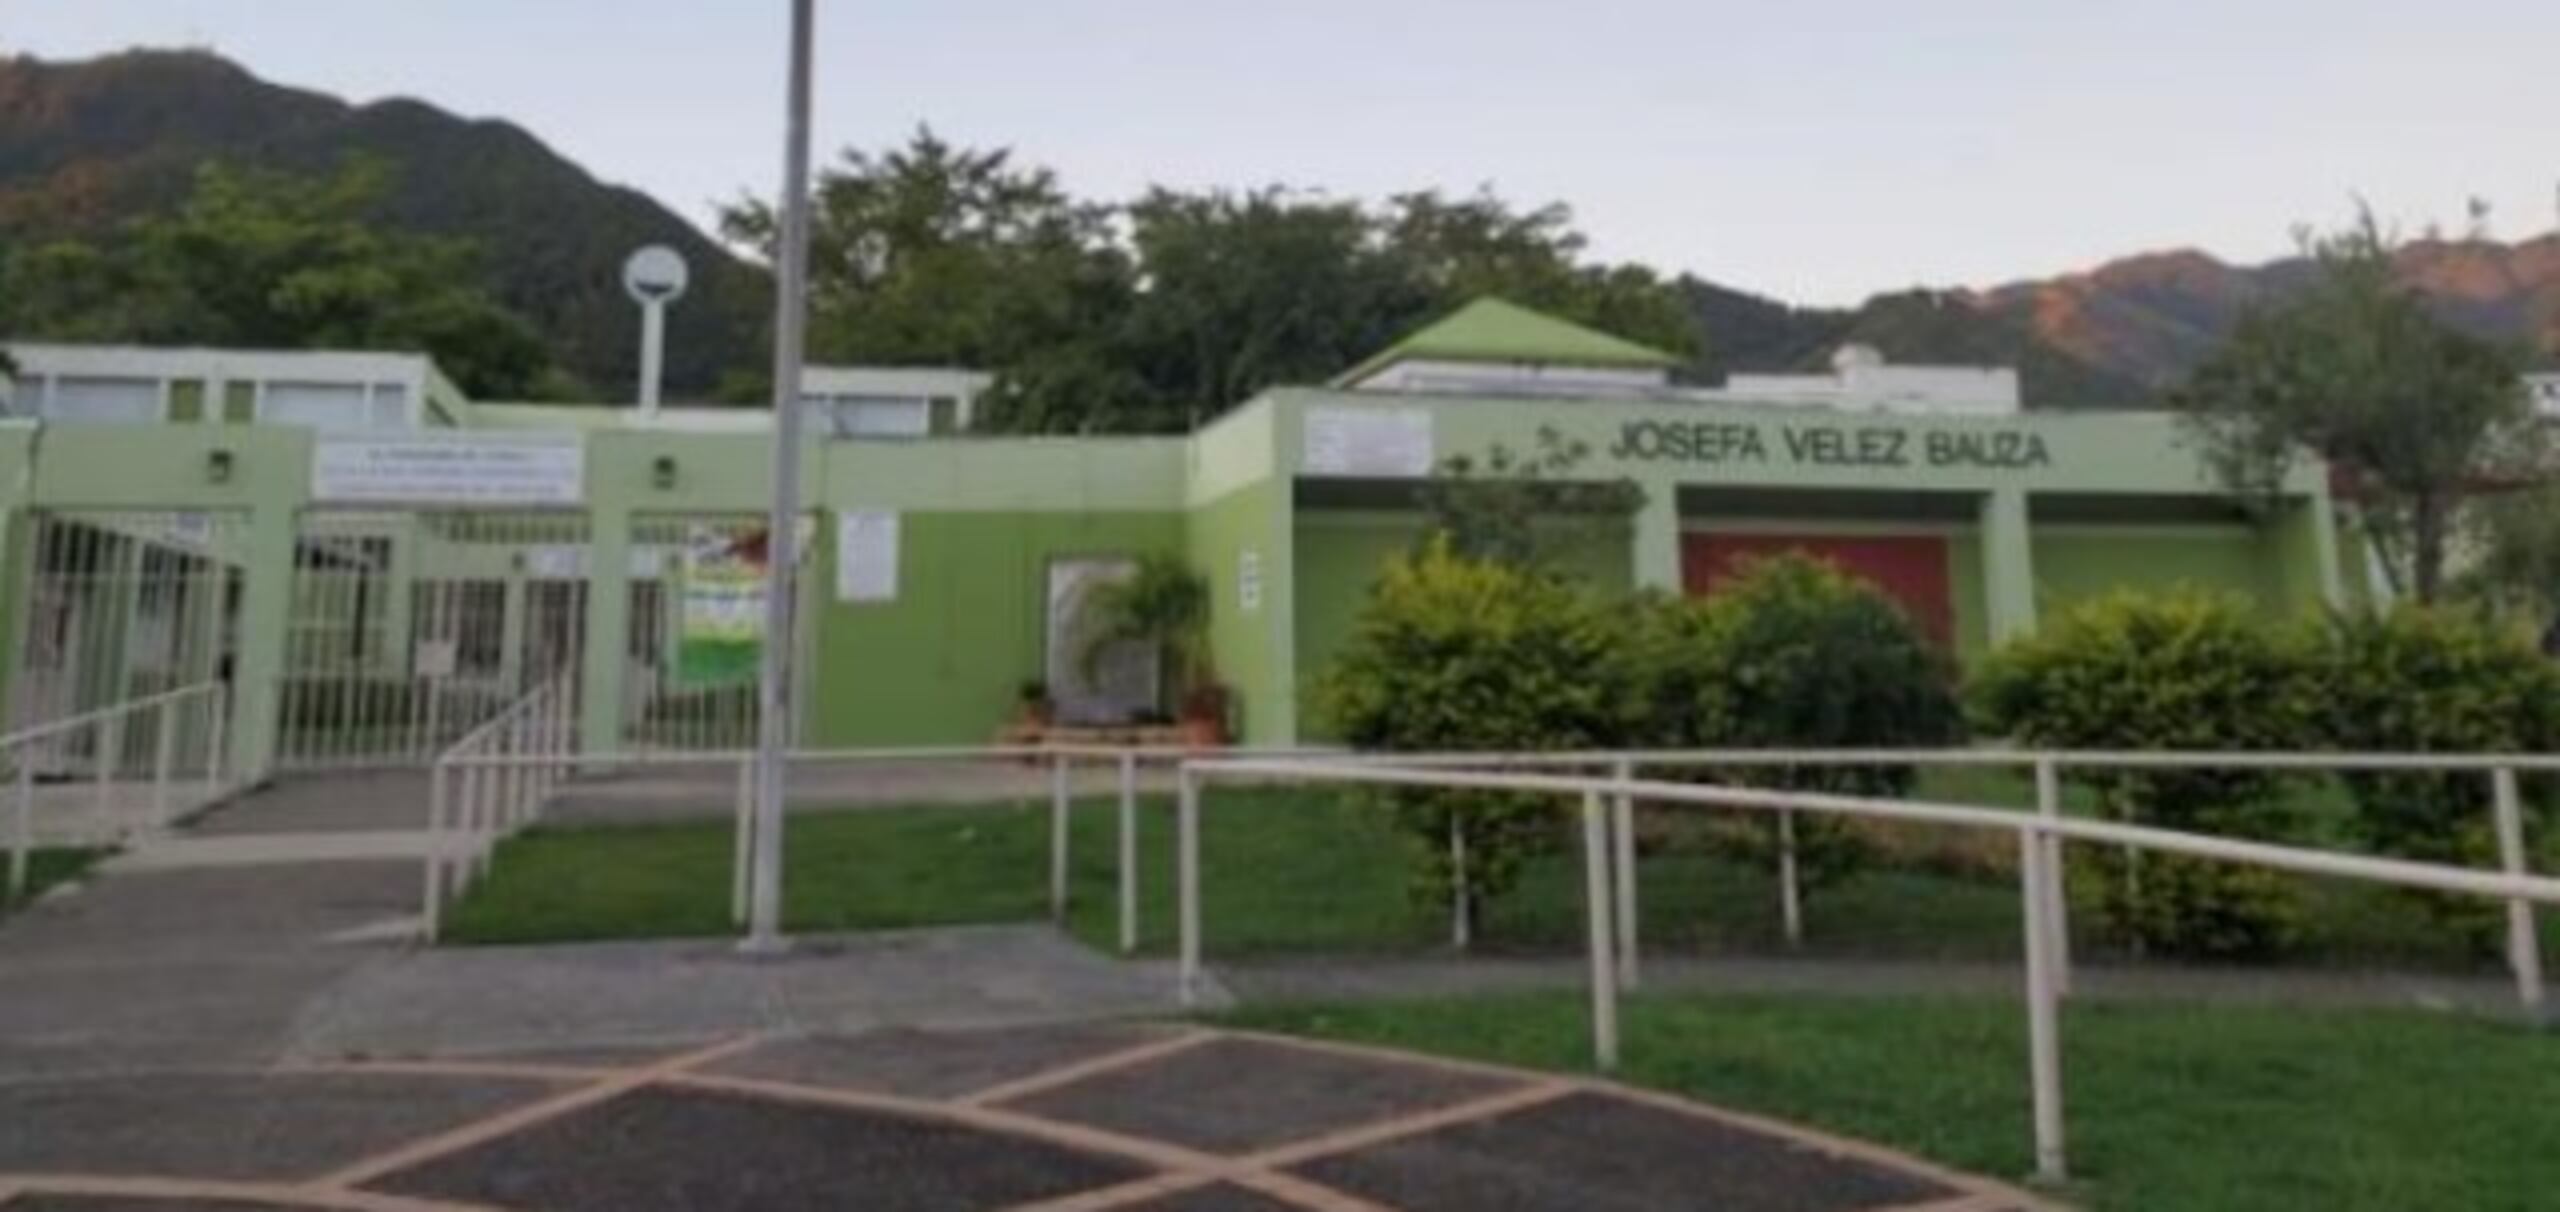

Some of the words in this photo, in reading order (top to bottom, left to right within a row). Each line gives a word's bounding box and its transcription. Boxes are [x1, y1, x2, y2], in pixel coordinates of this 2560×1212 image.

[1610, 420, 1766, 463] JOSEFA
[1783, 426, 1909, 466] VELEZ
[1925, 430, 2049, 468] BAUZA
